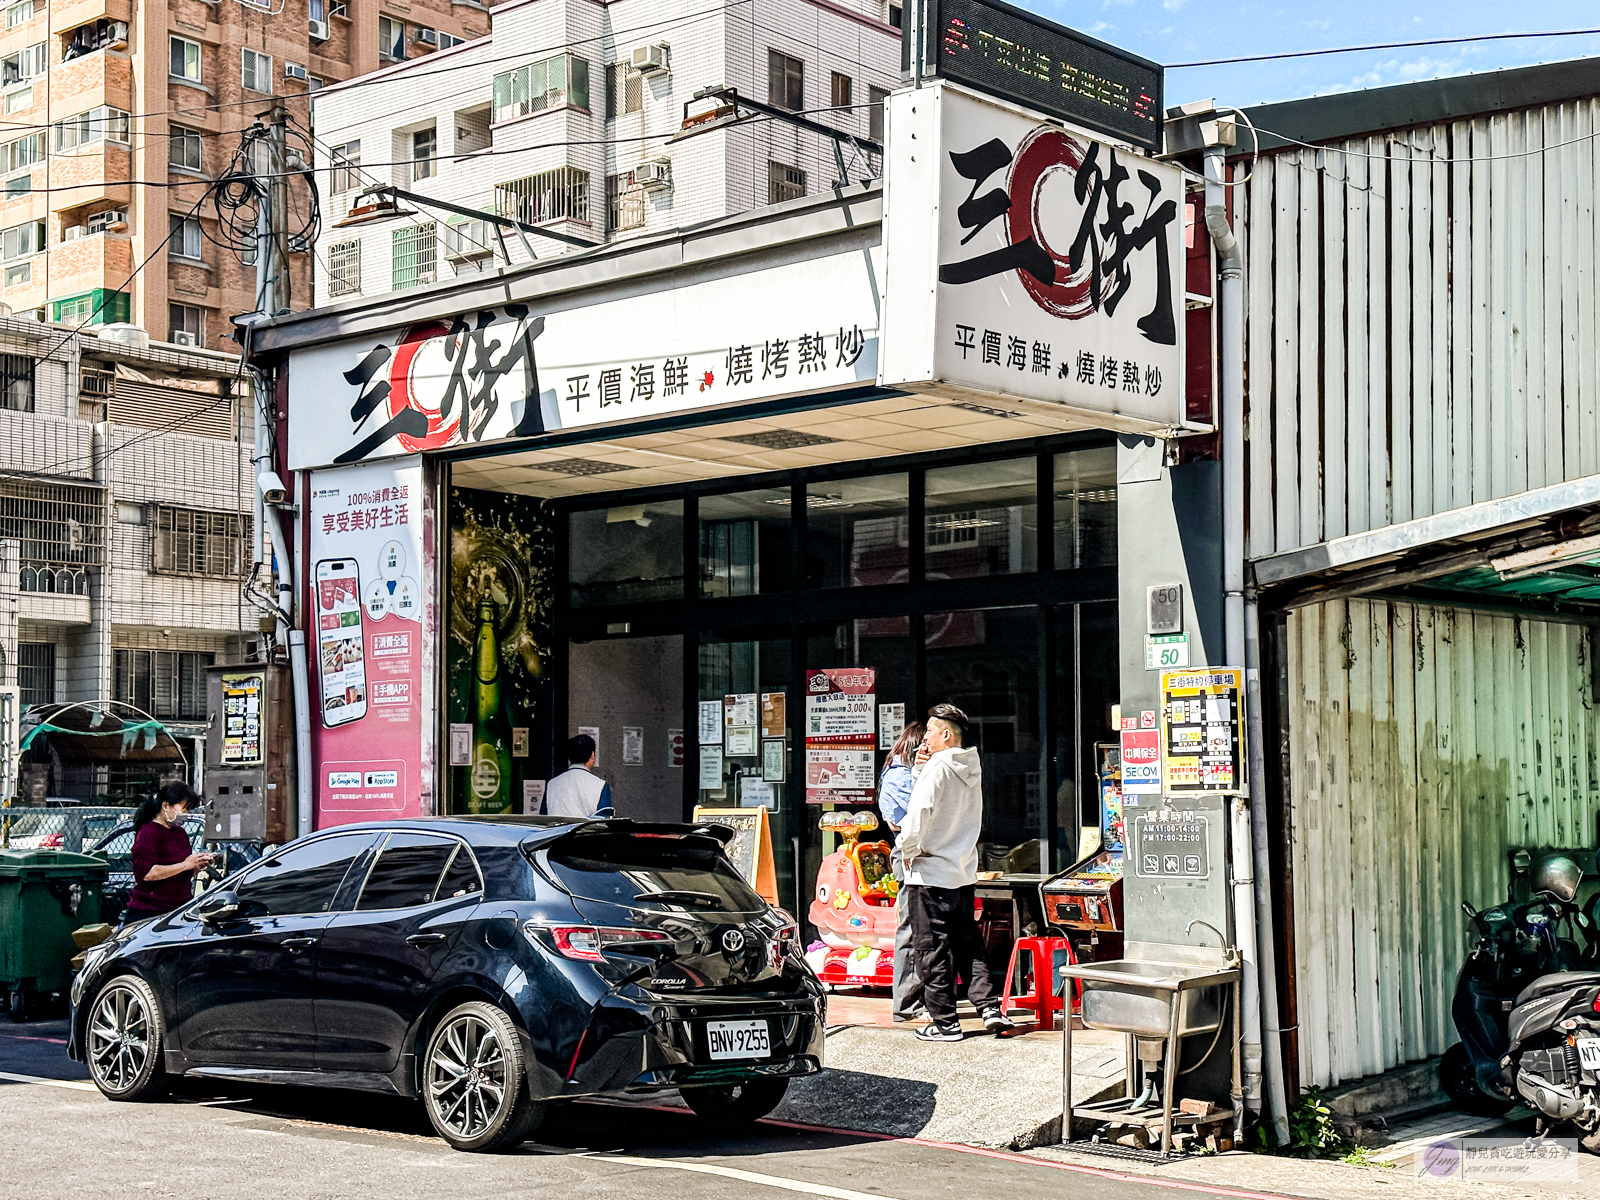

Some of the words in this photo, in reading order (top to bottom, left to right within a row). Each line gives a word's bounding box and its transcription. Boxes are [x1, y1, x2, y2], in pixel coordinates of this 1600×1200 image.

[566, 356, 689, 413] 平價海鮮
[725, 323, 866, 387] 燒烤熱炒
[954, 323, 1052, 377] 平價海鮮
[1076, 349, 1164, 398] 燒烤熱炒
[347, 484, 409, 507] 100%消費全返
[322, 503, 409, 536] 享受美好生活
[1158, 587, 1177, 604] 50
[379, 634, 408, 649] 消費全返
[1160, 648, 1180, 666] 50
[1169, 674, 1235, 688] 三街特約停車場
[379, 683, 408, 696] 手機APP
[1125, 766, 1158, 778] SECOM
[1147, 810, 1194, 823] 營業時間
[1143, 834, 1155, 842] PM
[1156, 834, 1200, 842] 17:00-22:00
